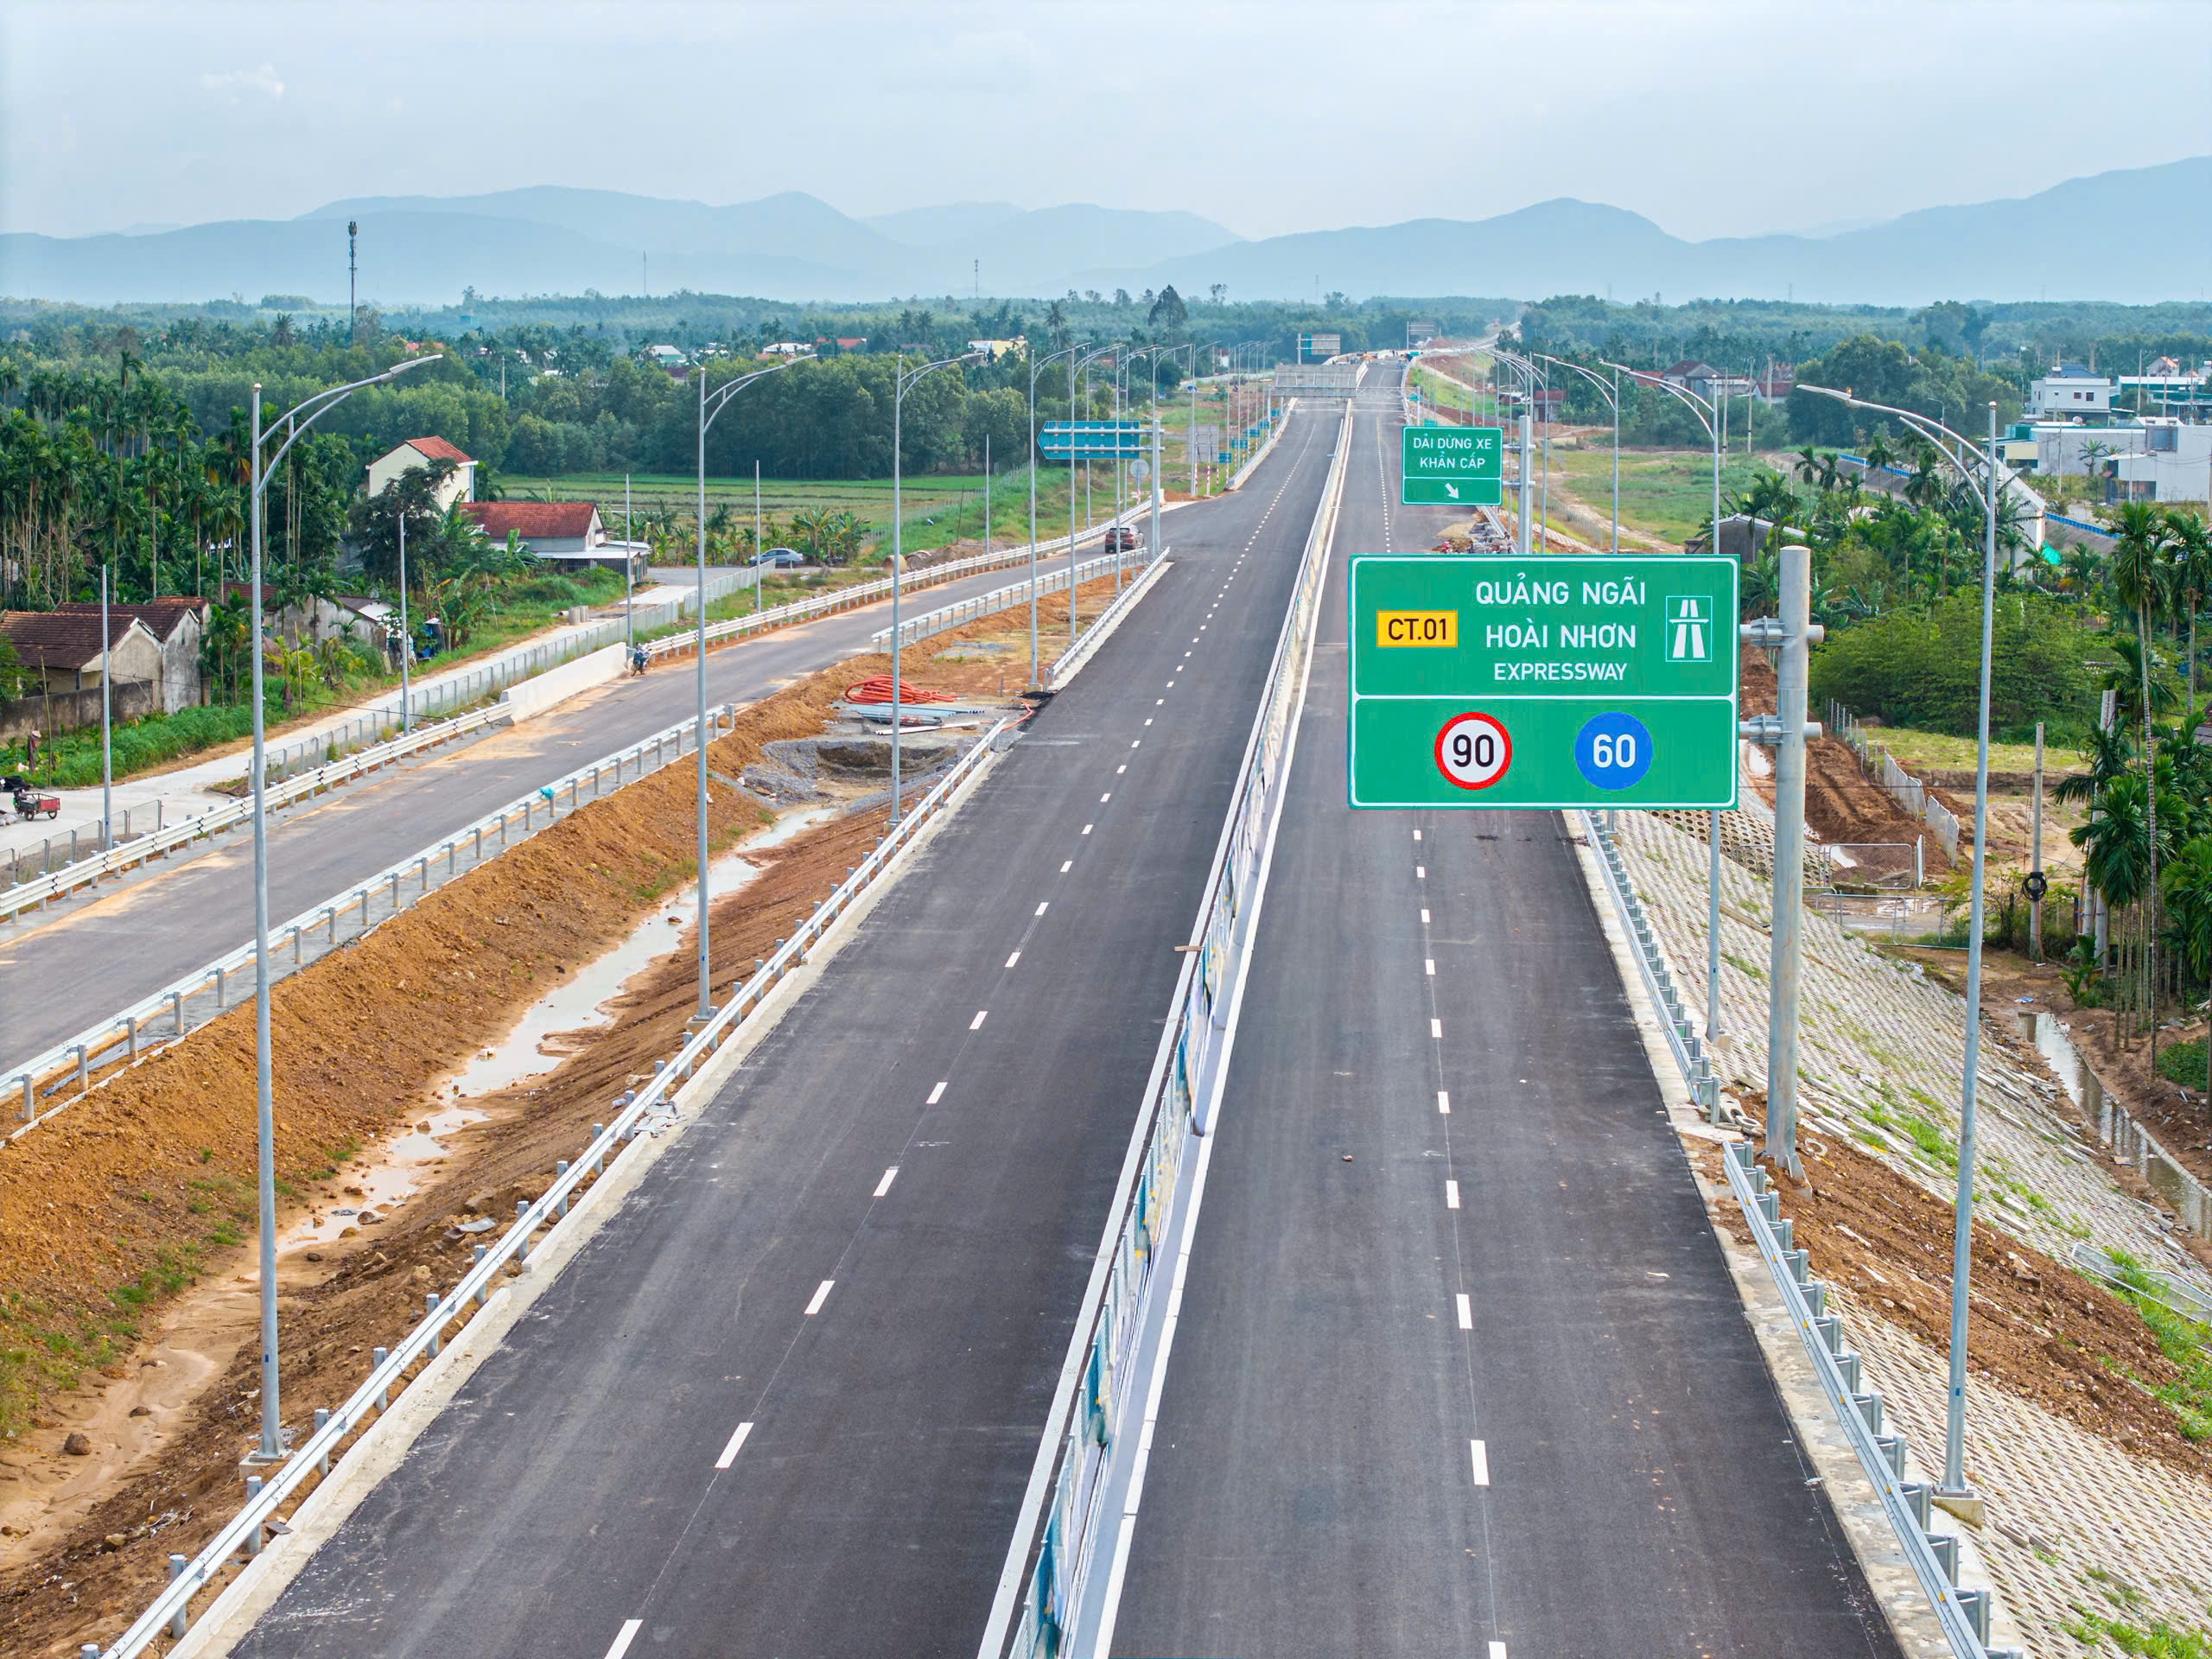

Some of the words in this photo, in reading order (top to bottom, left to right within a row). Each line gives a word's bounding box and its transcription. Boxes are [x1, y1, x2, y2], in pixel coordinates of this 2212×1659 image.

[1414, 433, 1433, 448] DẢI
[1476, 438, 1492, 449] XE
[1420, 451, 1455, 468] KHẨN
[1460, 452, 1485, 468] CẤP
[1476, 572, 1570, 606] QUẢNG
[1582, 575, 1646, 606] NGÃI
[1388, 618, 1448, 641] CT.01
[1485, 617, 1548, 649] HOÀI
[1560, 622, 1637, 649] NHƠN
[1493, 663, 1628, 682] EXPRESSWAY
[1452, 734, 1496, 768] 90
[1592, 734, 1636, 768] 60
